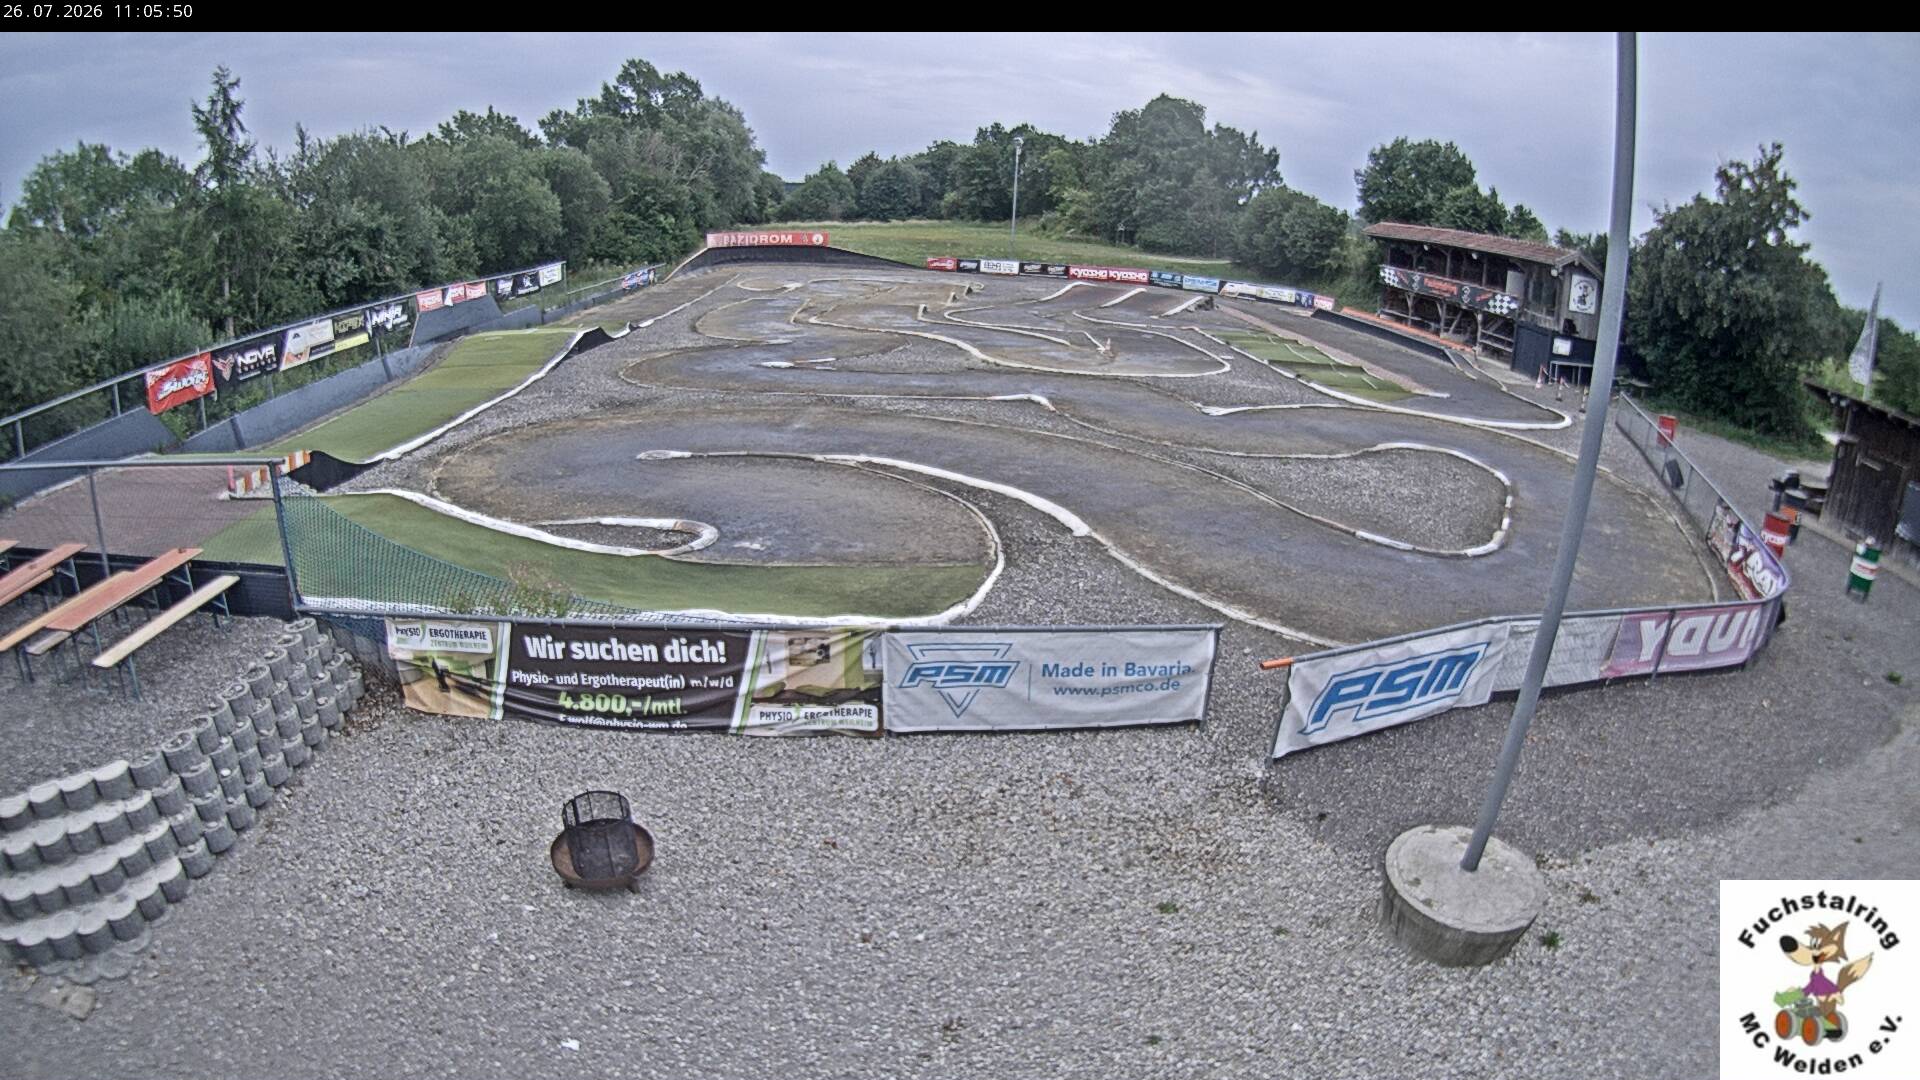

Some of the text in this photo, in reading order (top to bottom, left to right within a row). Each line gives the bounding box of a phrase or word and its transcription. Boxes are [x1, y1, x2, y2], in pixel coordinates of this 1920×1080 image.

[429, 628, 487, 640] ERGOTHERAPIE
[524, 634, 727, 664] Wir suchen dich!
[511, 669, 734, 690] Physio- und Ergotherapeut(in) m/w/d
[906, 664, 1013, 684] PSM
[1041, 662, 1095, 678] Made
[1101, 662, 1117, 677] in
[1053, 679, 1180, 698] www.psmco.de
[1310, 650, 1482, 726] PSM
[759, 711, 792, 722] PHYSIO
